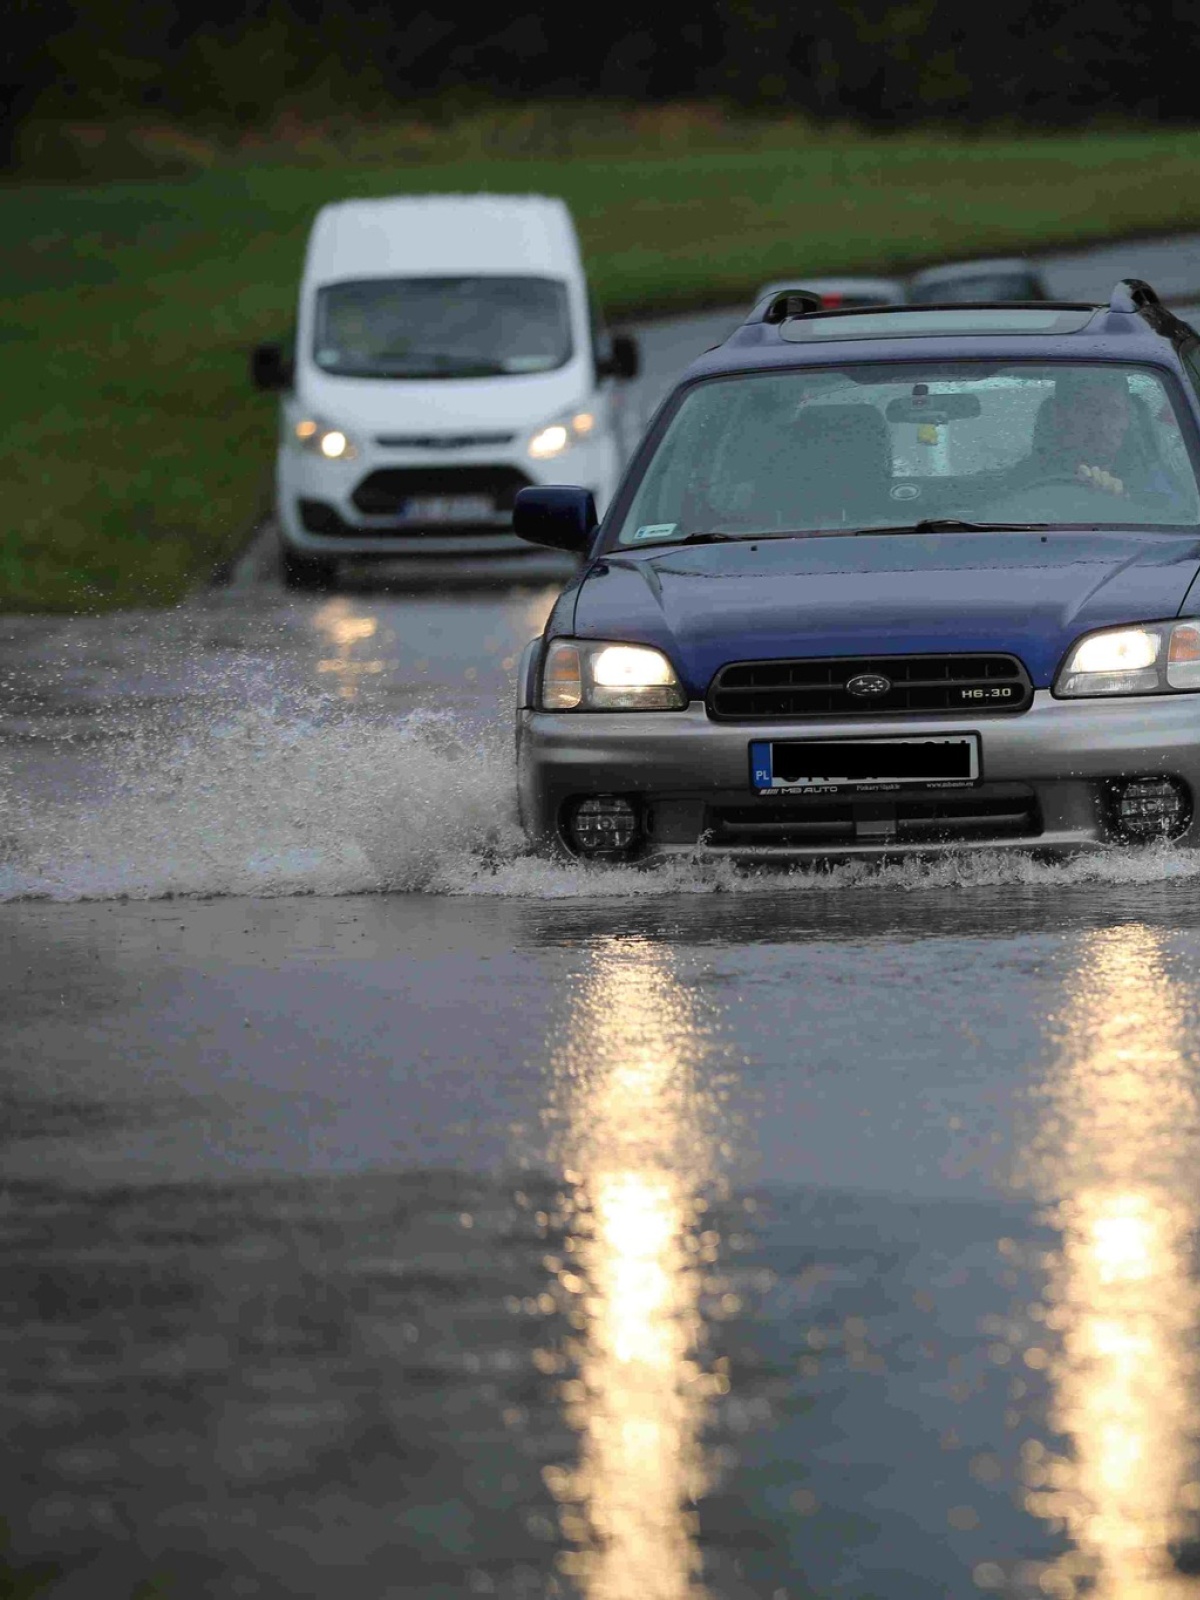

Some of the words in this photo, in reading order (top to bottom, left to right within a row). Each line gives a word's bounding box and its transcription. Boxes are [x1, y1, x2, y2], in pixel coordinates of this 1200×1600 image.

[962, 688, 1012, 698] H6.30
[756, 770, 770, 780] PL
[781, 787, 802, 795] MB
[803, 786, 838, 794] AUTO
